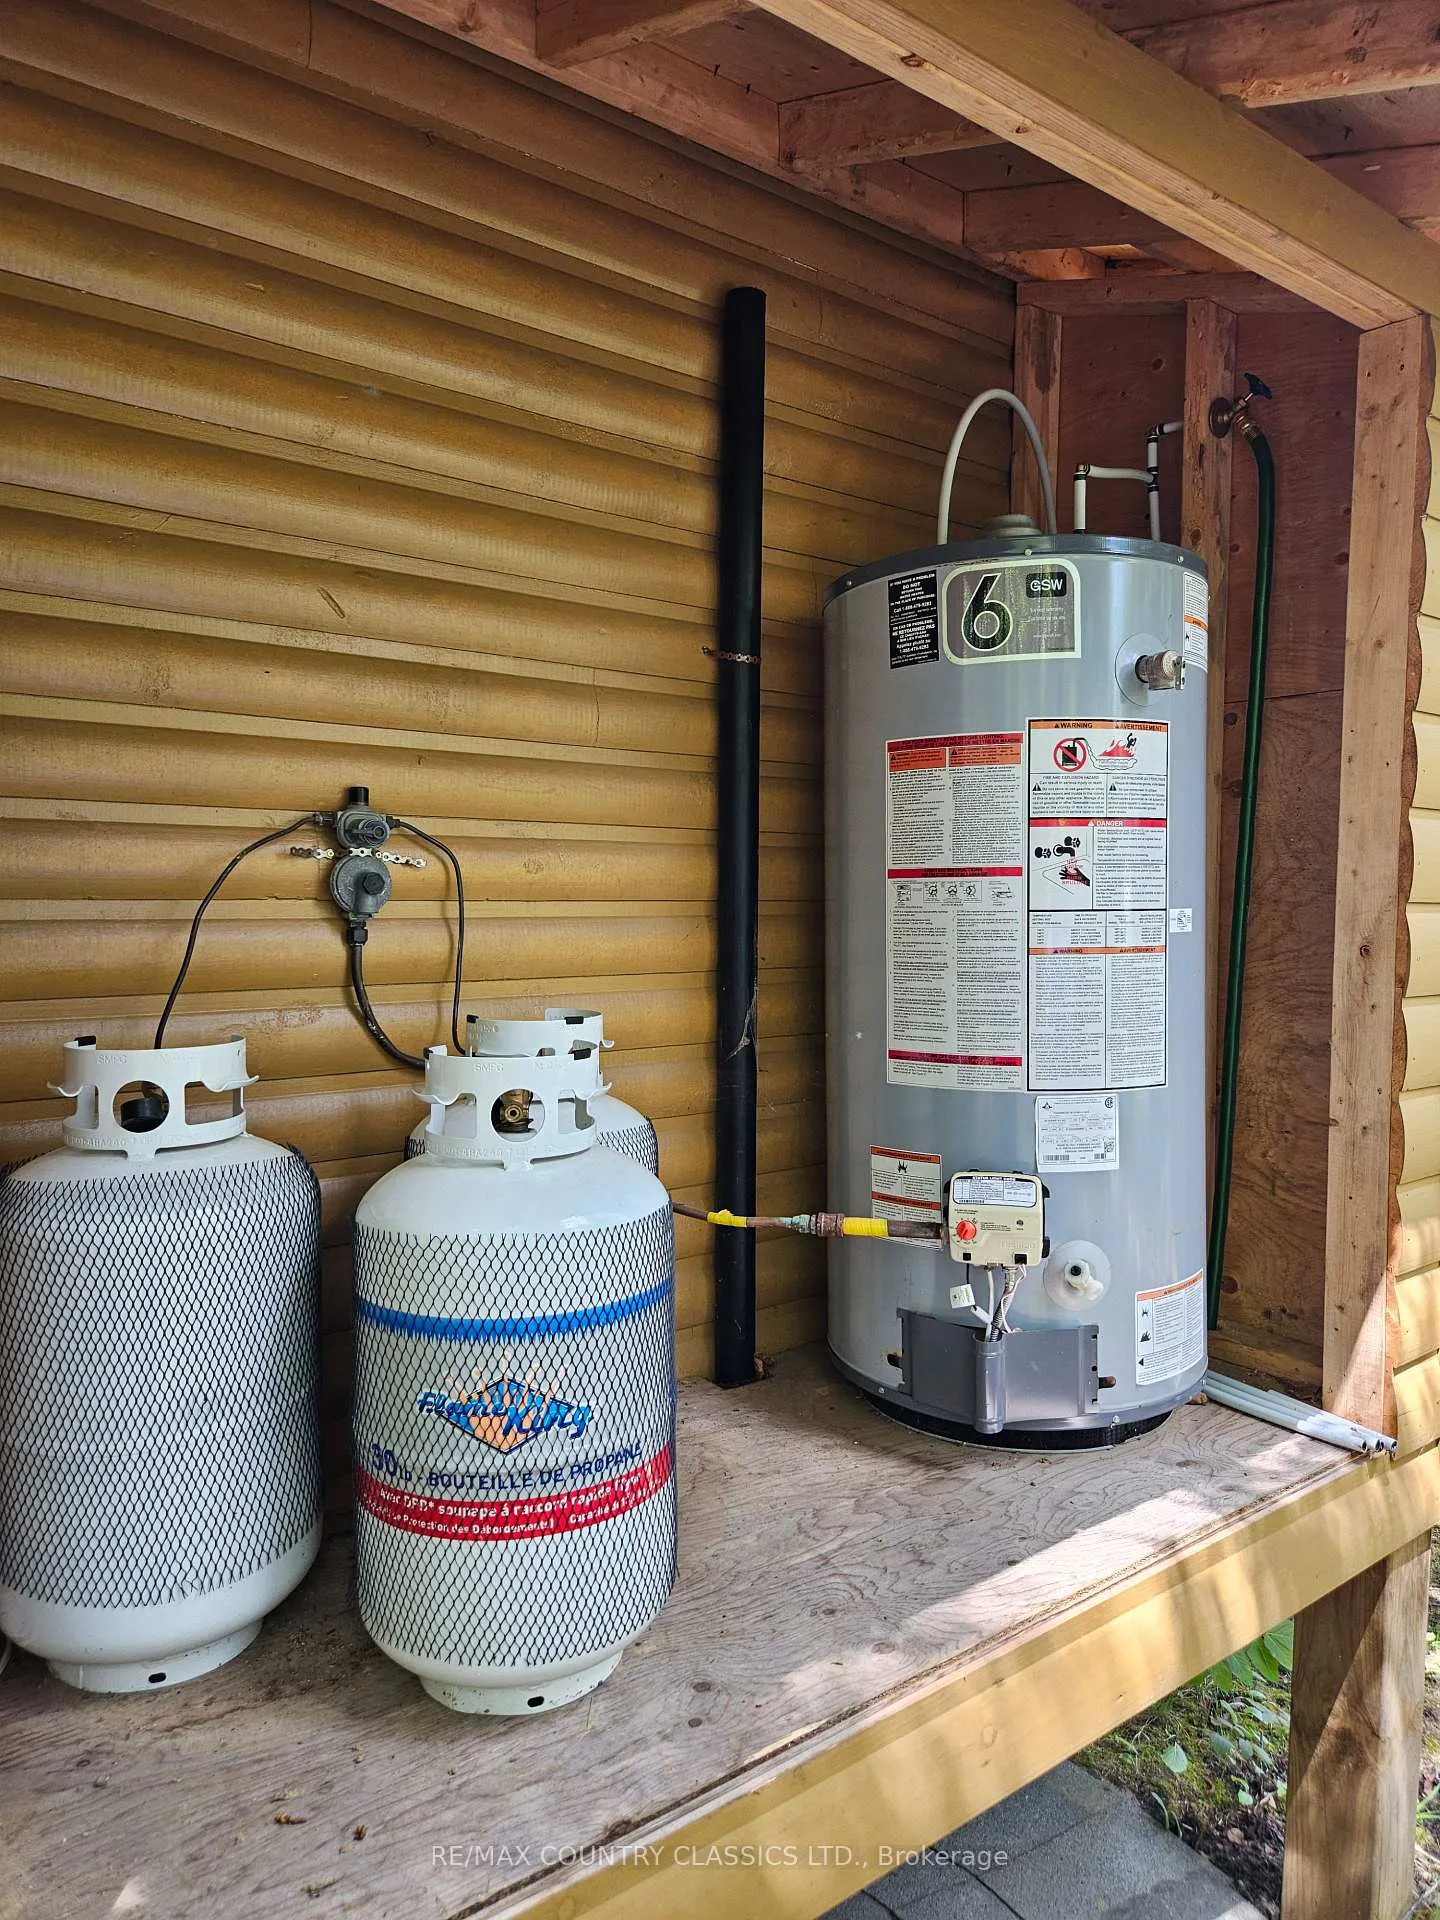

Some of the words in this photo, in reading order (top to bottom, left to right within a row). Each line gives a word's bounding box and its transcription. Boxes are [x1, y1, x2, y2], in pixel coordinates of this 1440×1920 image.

[1030, 578, 1063, 592] GSW
[961, 572, 1014, 652] 6
[1120, 724, 1162, 732] AVERTISSEMENT
[416, 1392, 505, 1418] Flame
[502, 1403, 594, 1440] King
[372, 1442, 398, 1476] 30
[428, 1472, 533, 1490] BOUTEILLE
[540, 1468, 564, 1484] DE
[570, 1441, 642, 1480] PROPANE
[438, 1504, 498, 1522] soupape
[514, 1496, 568, 1516] raccord
[571, 1486, 611, 1506] rapide
